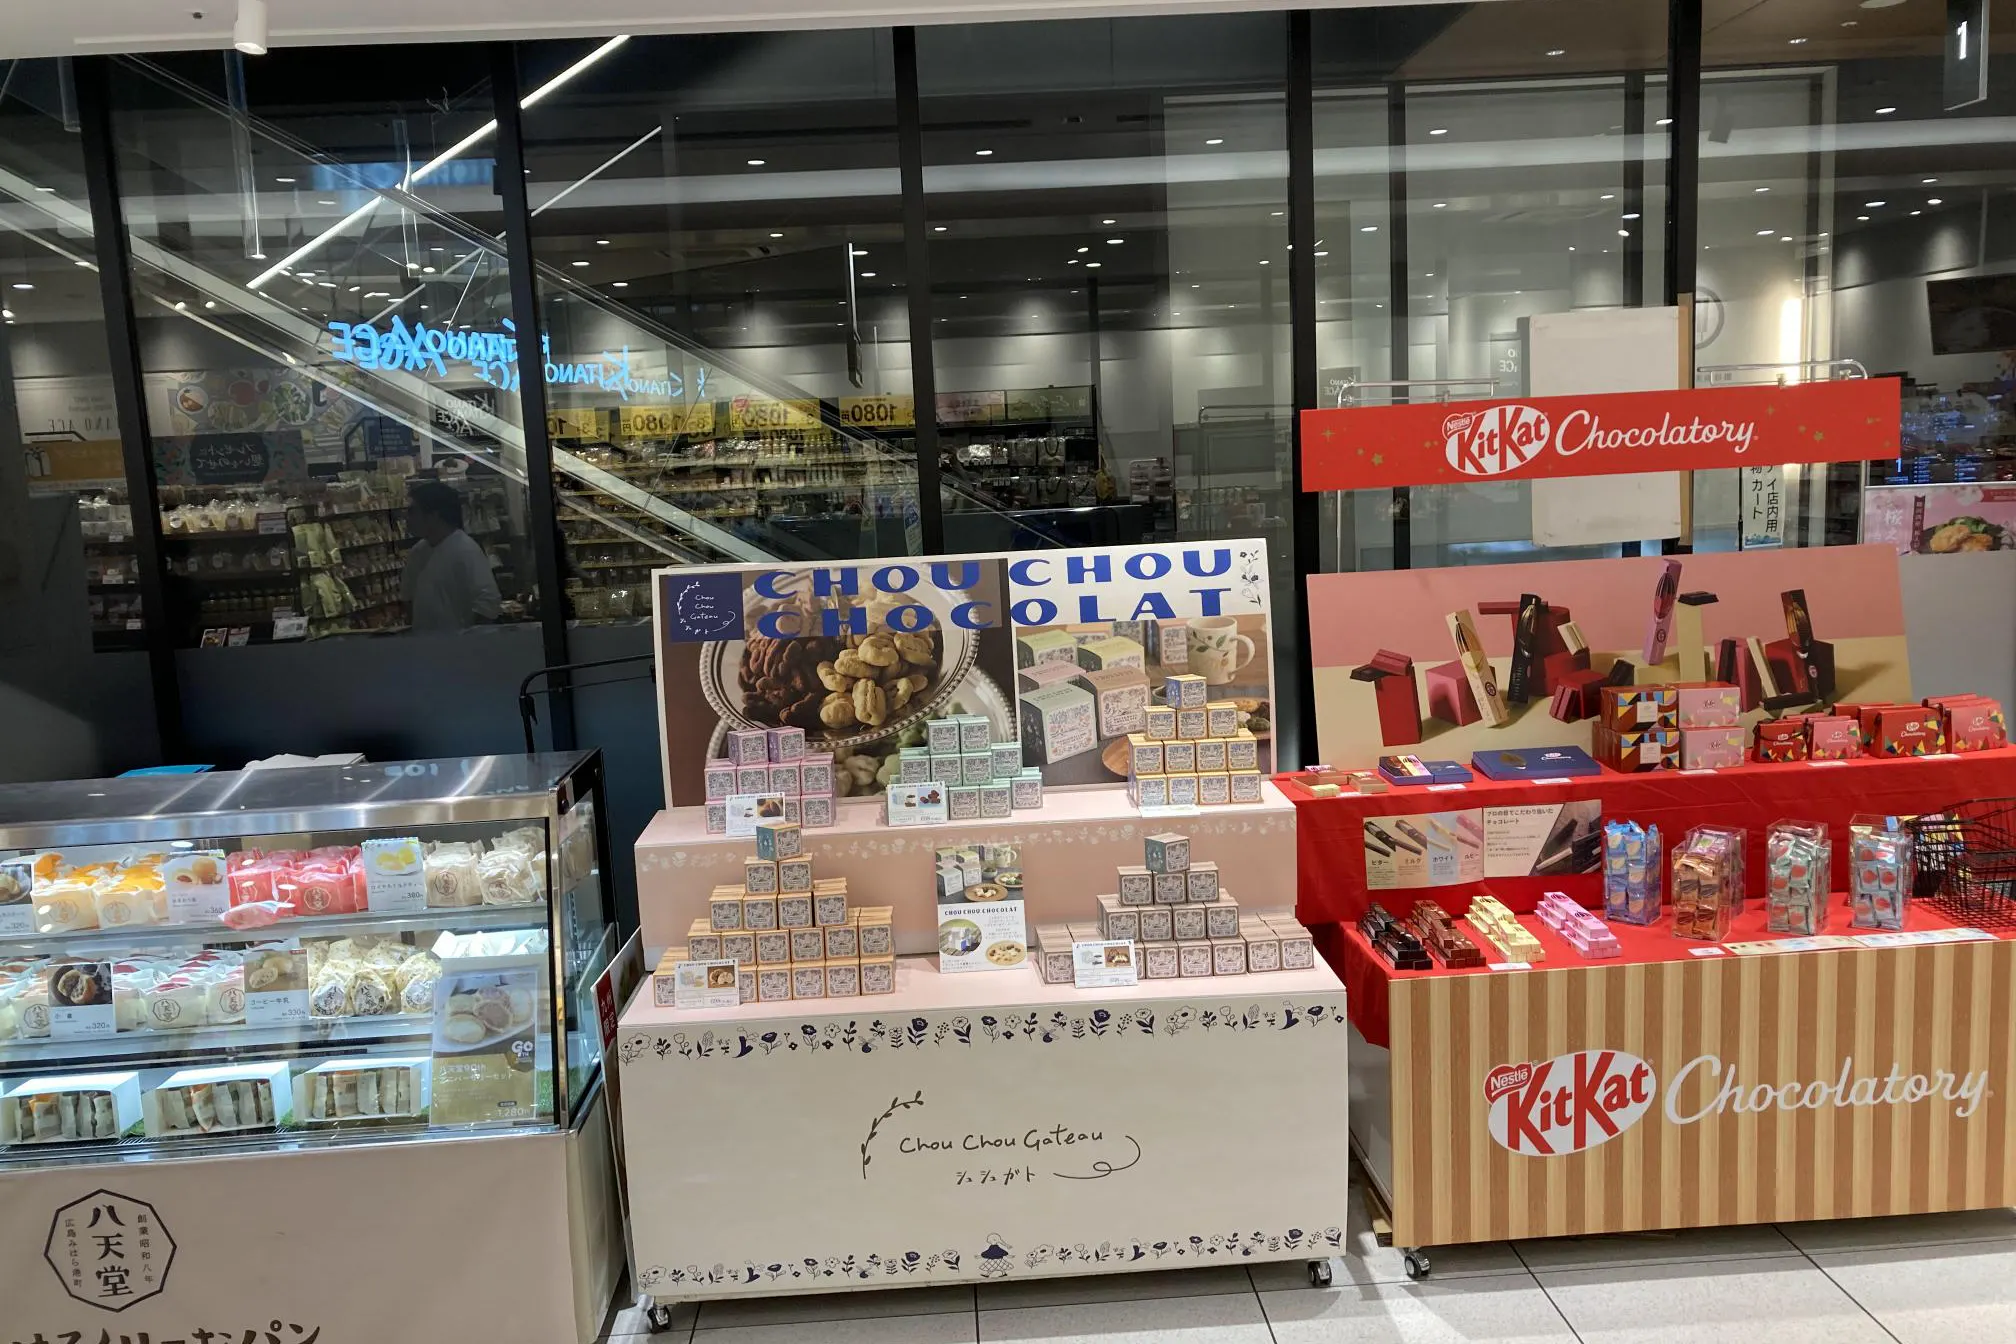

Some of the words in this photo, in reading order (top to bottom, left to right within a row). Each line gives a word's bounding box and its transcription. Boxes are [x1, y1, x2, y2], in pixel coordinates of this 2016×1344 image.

[1957, 20, 1968, 60] 1
[1457, 406, 1546, 474] KitKat
[1555, 409, 1756, 456] Chocolatory
[753, 562, 980, 601] CHOU
[1009, 549, 1231, 587] CHOU
[757, 587, 1232, 640] CHOCOLAT
[1507, 1051, 1649, 1154] KitKat
[1666, 1054, 1988, 1125] Chocolatory
[899, 1137, 953, 1154] Chou
[962, 1134, 1016, 1151] Chou
[1023, 1124, 1103, 1151] Gateau
[87, 1203, 134, 1298] 八天堂
